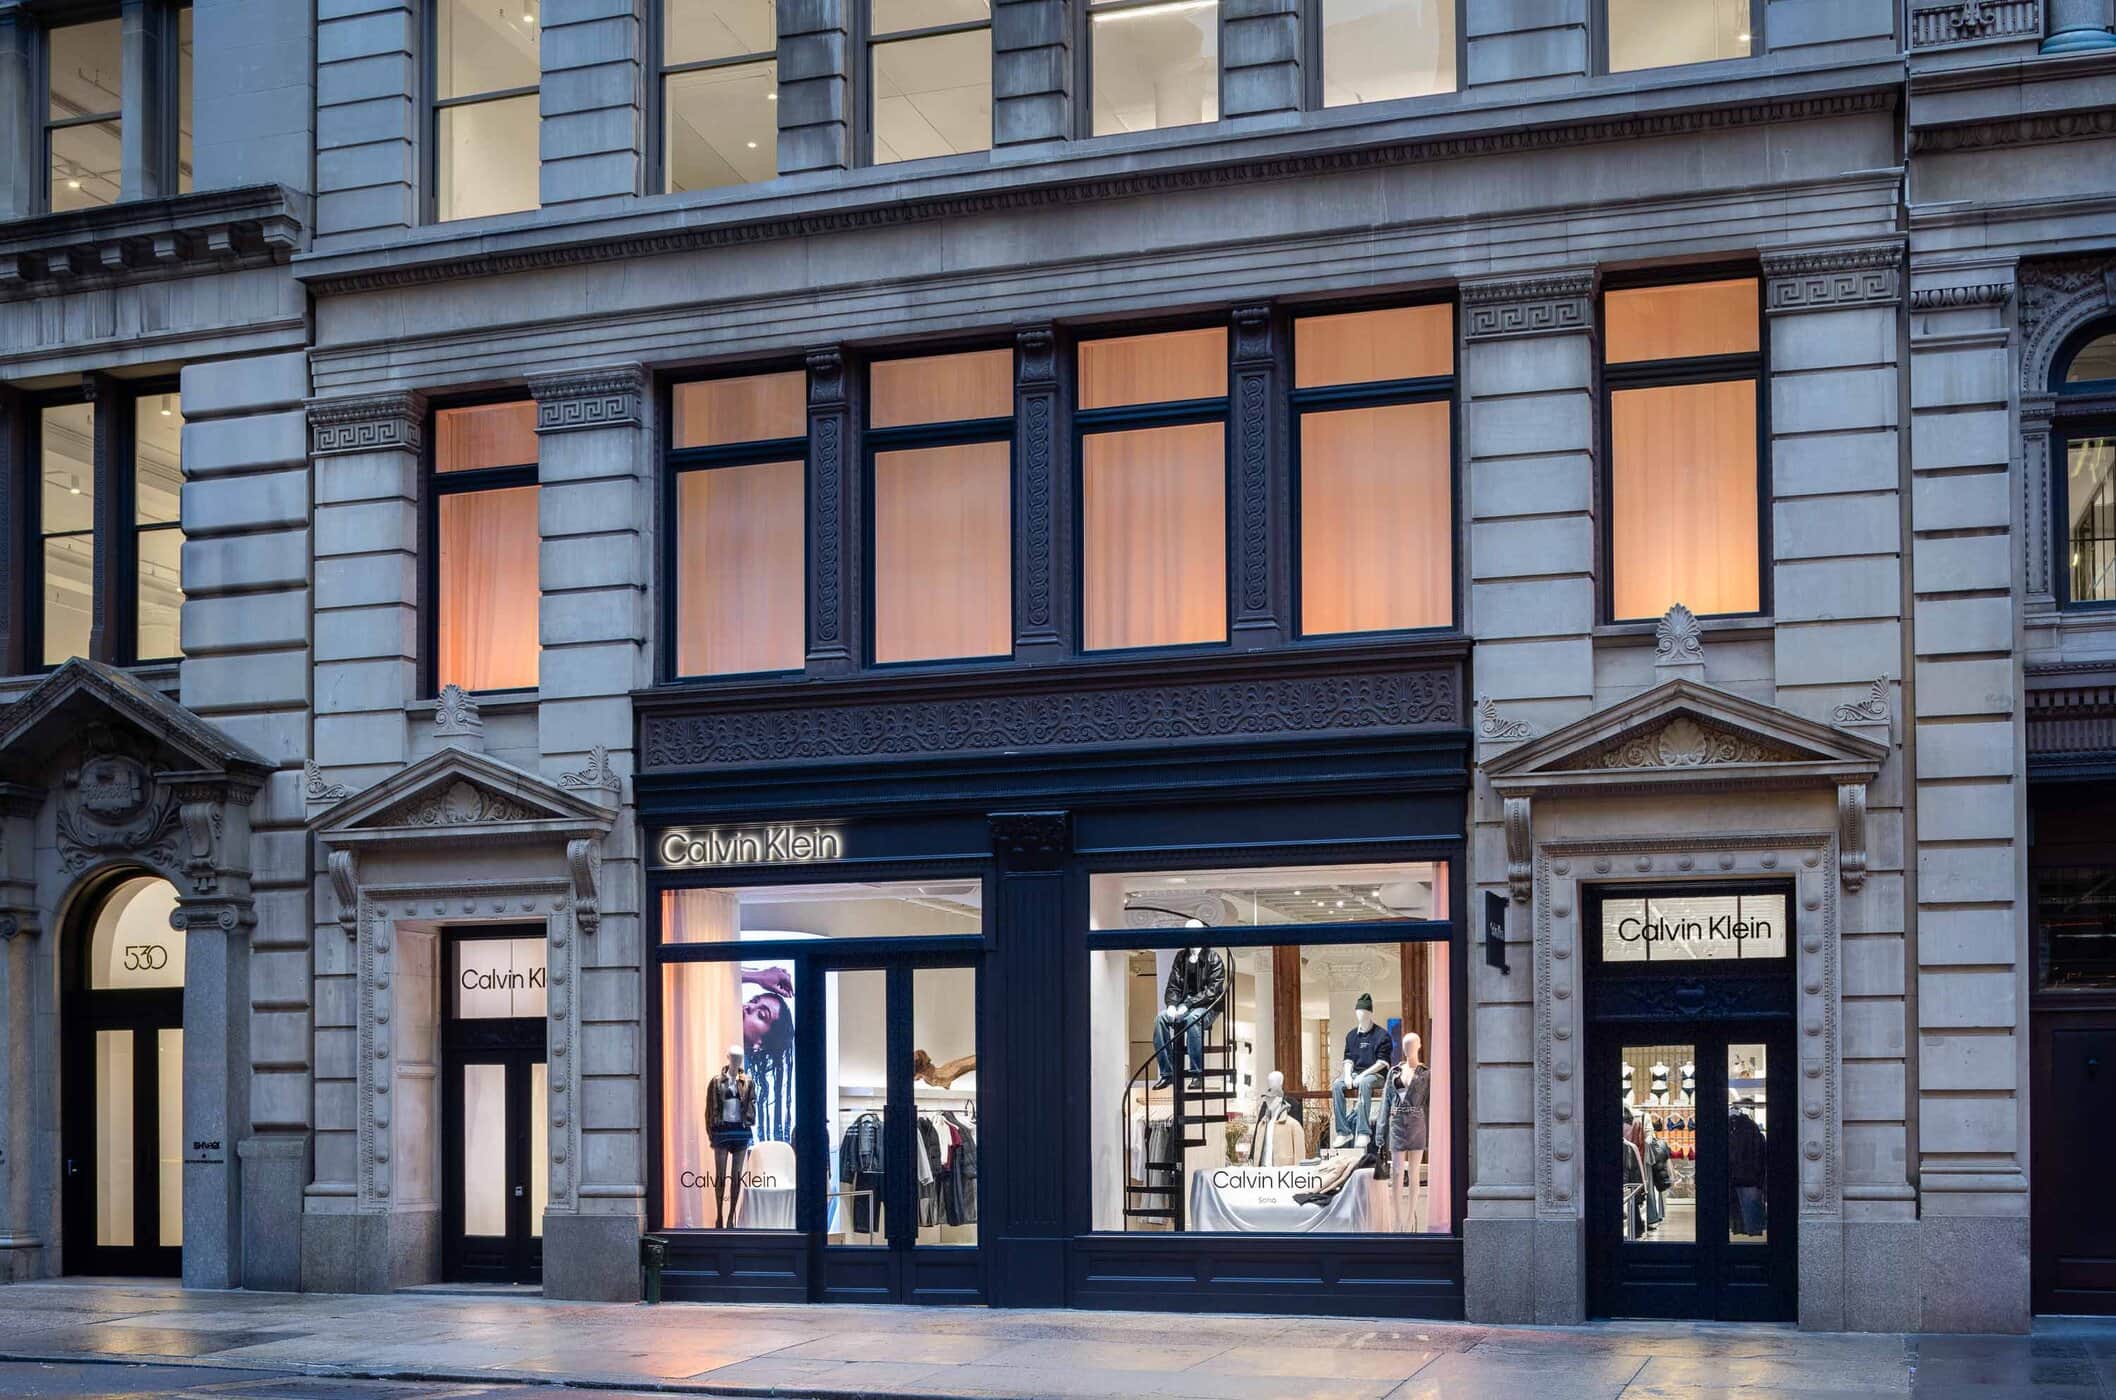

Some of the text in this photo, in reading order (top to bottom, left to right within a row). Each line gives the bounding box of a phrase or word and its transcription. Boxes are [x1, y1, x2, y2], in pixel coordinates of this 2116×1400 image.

[661, 825, 840, 864] Calvin Klein
[1618, 915, 1771, 942] Calvin Klein
[124, 945, 168, 970] 530
[461, 967, 546, 990] Calvin Kl
[738, 1170, 777, 1188] Klein
[1213, 1170, 1323, 1189] Calvin Klein
